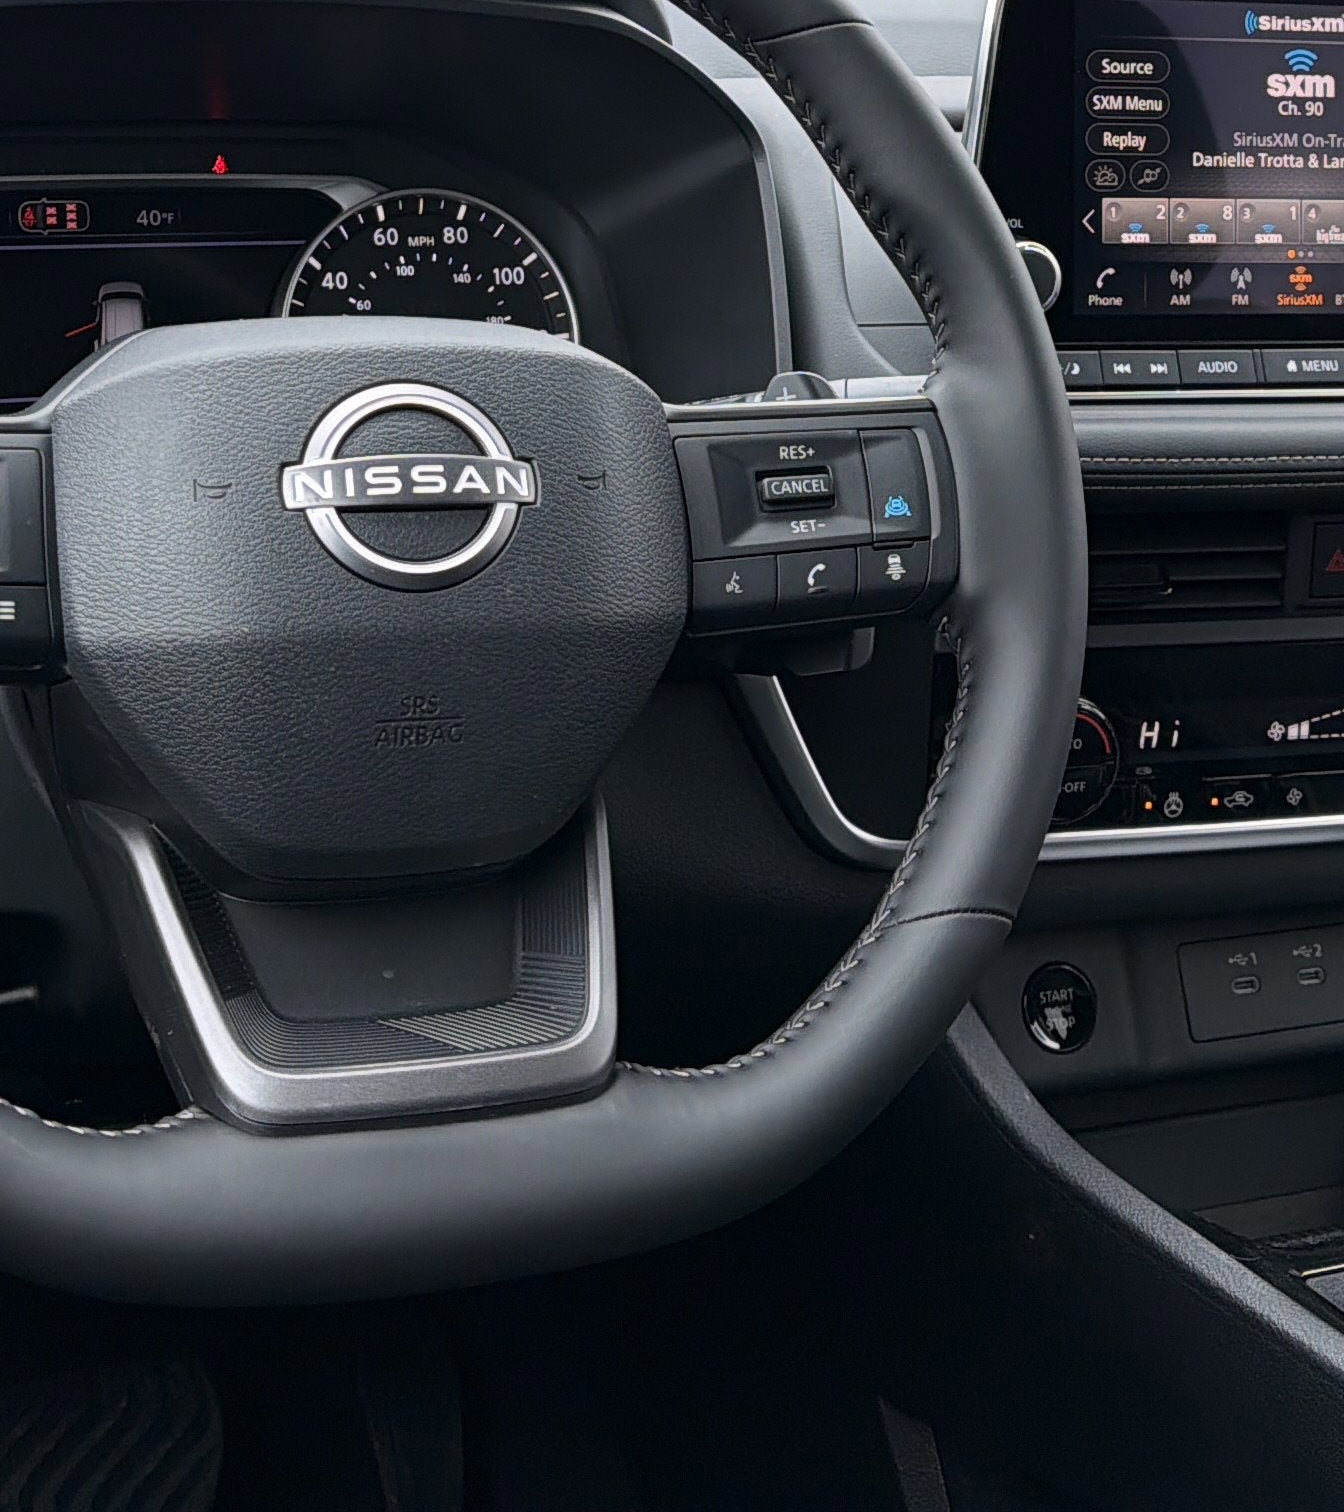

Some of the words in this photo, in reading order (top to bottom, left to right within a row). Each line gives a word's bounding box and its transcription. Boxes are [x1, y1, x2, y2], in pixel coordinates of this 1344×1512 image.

[1101, 59, 1154, 74] Source
[1092, 96, 1122, 110] SXM
[1126, 96, 1162, 112] Menu
[1278, 102, 1301, 116] Ch.
[1305, 102, 1324, 116] 90
[1103, 132, 1146, 151] Replay
[1234, 132, 1298, 148] SiriusXM
[1192, 152, 1254, 168] Danielle
[1258, 153, 1304, 168] Trotta
[1308, 154, 1319, 168] &
[1110, 208, 1116, 218] 1
[1156, 205, 1166, 220] 2
[1176, 208, 1184, 218] 2
[1222, 205, 1232, 220] 8
[1243, 208, 1250, 219] 3
[1290, 206, 1296, 220] 1
[1308, 208, 1316, 219] 4
[374, 227, 398, 246] 60
[408, 236, 434, 247] MPH
[443, 226, 468, 244] 80
[396, 265, 414, 276] 100
[492, 267, 525, 285] 100
[322, 272, 348, 290] 40
[453, 273, 471, 284] 140
[356, 299, 372, 311] 60
[1088, 294, 1122, 306] Phone
[1170, 295, 1190, 306] AM
[1232, 295, 1248, 306] FM
[1277, 294, 1323, 306] SiriusXM
[1198, 360, 1238, 374] AUDIO
[1302, 360, 1339, 372] MENU
[779, 445, 815, 460] RES+
[290, 464, 530, 503] NISSAN
[771, 479, 828, 495] CANCEL
[400, 696, 440, 717] SRS
[375, 725, 465, 748] AIRBAG
[1139, 720, 1180, 750] Hi
[1064, 782, 1086, 794] OFF
[1313, 944, 1322, 957] 2
[1040, 988, 1074, 1005] START
